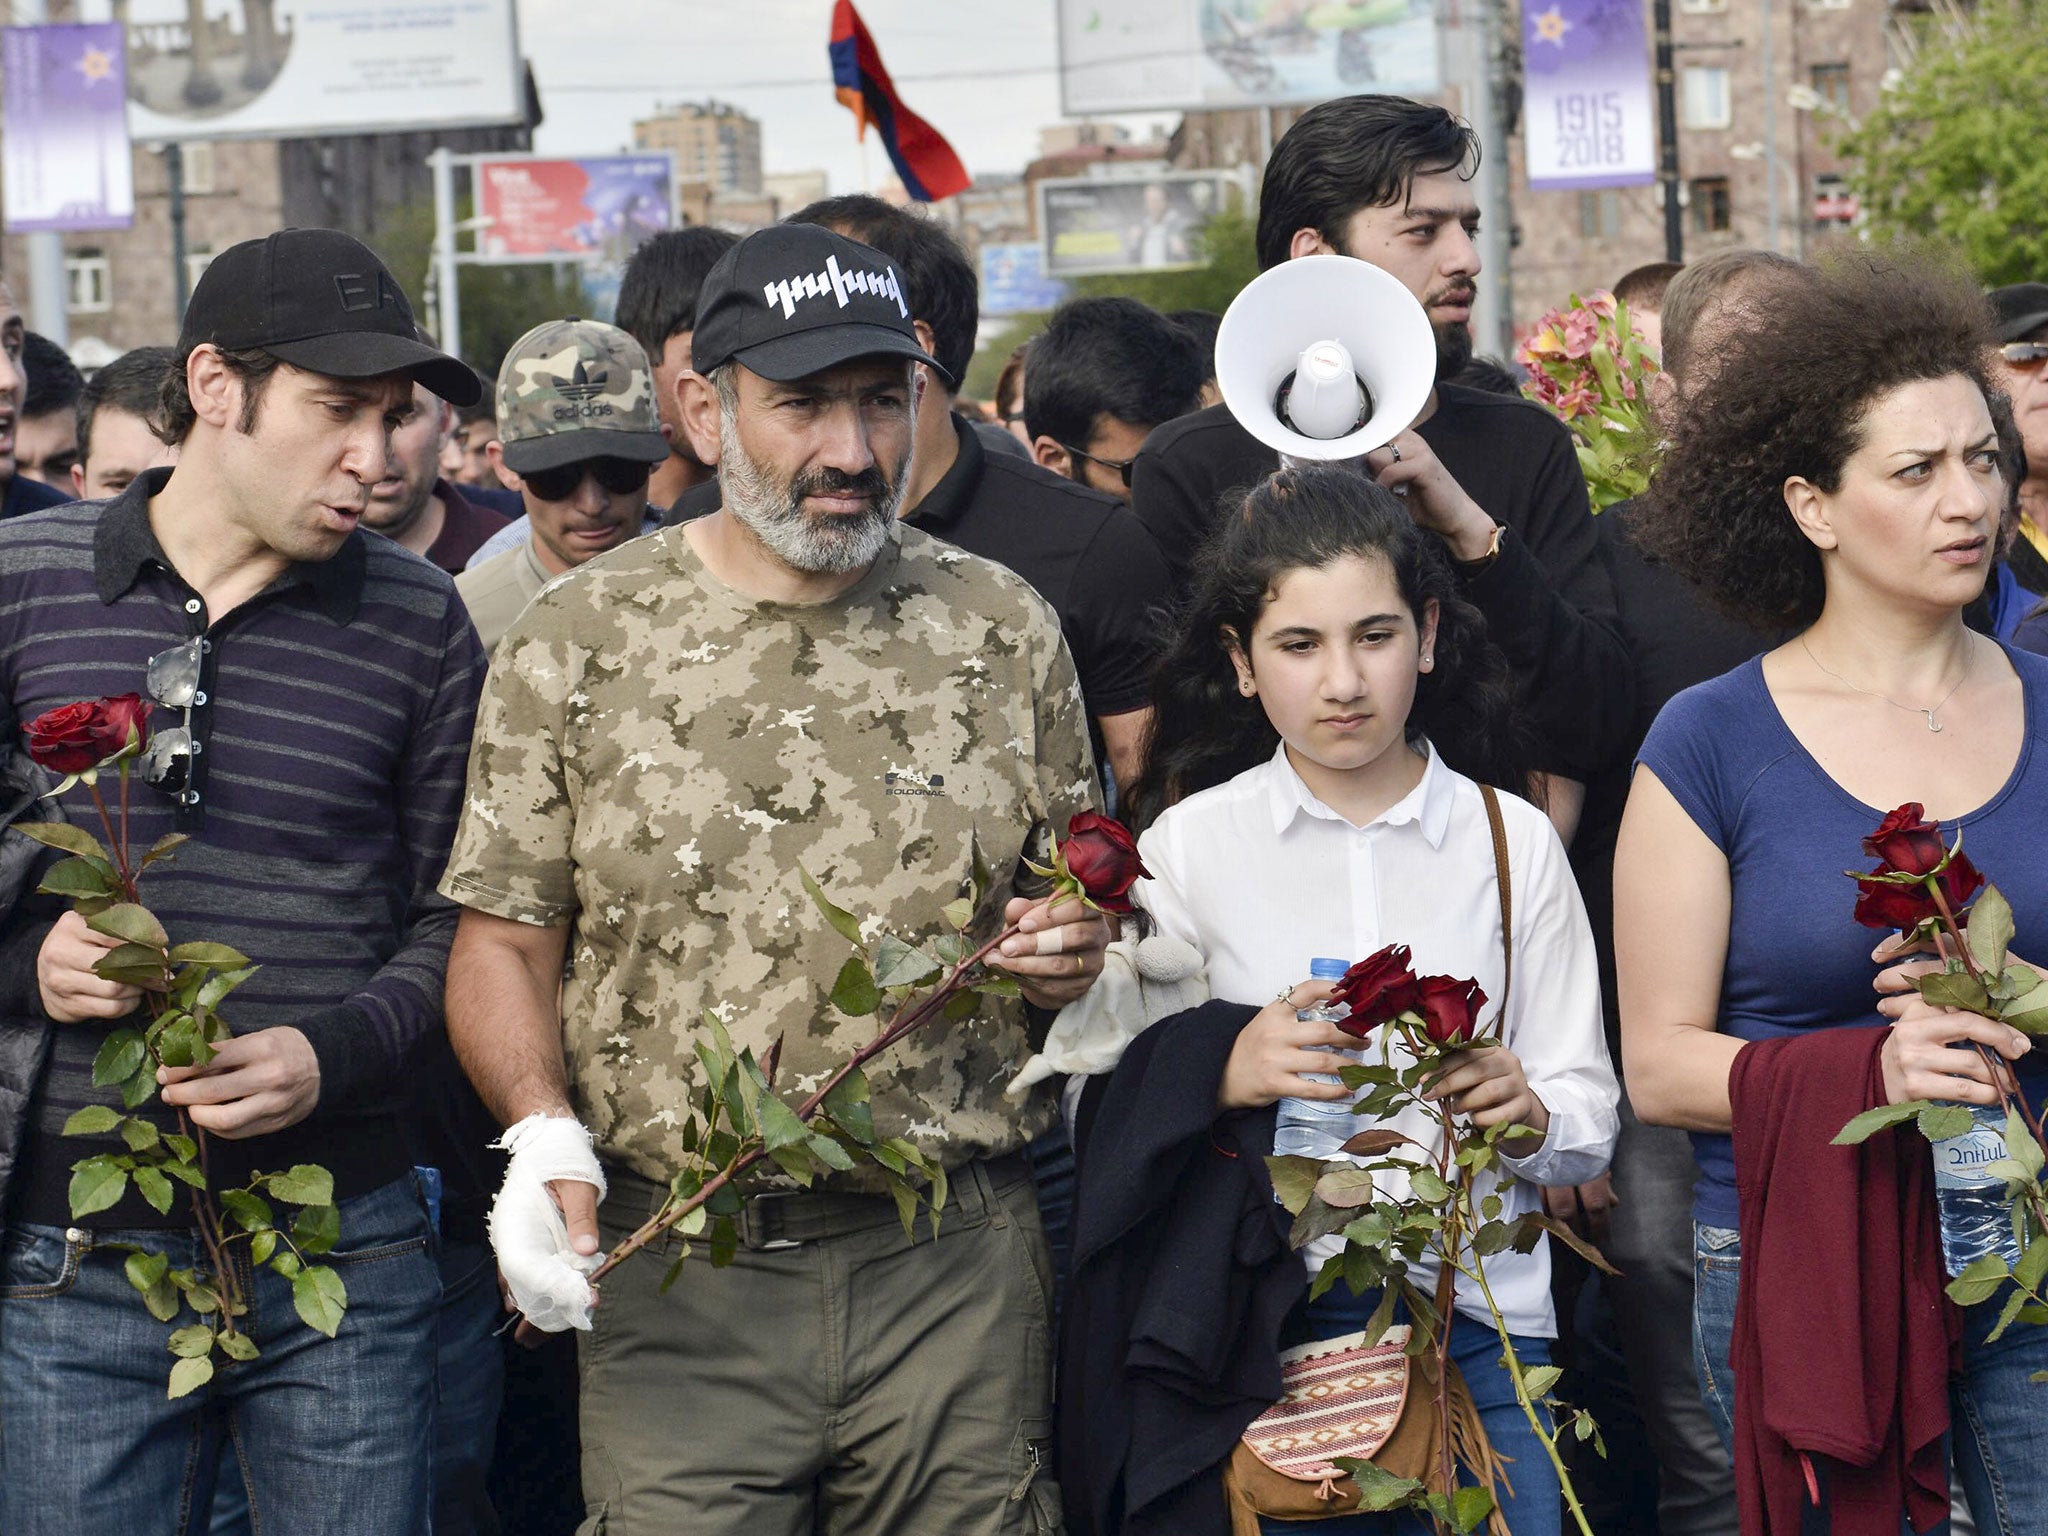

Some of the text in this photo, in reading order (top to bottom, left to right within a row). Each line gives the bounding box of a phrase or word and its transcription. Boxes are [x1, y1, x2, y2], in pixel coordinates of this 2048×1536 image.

[1554, 91, 1623, 132] 1915
[1556, 133, 1626, 168] 2018
[552, 401, 613, 421] adidas
[885, 788, 946, 798] SOLOGNAC
